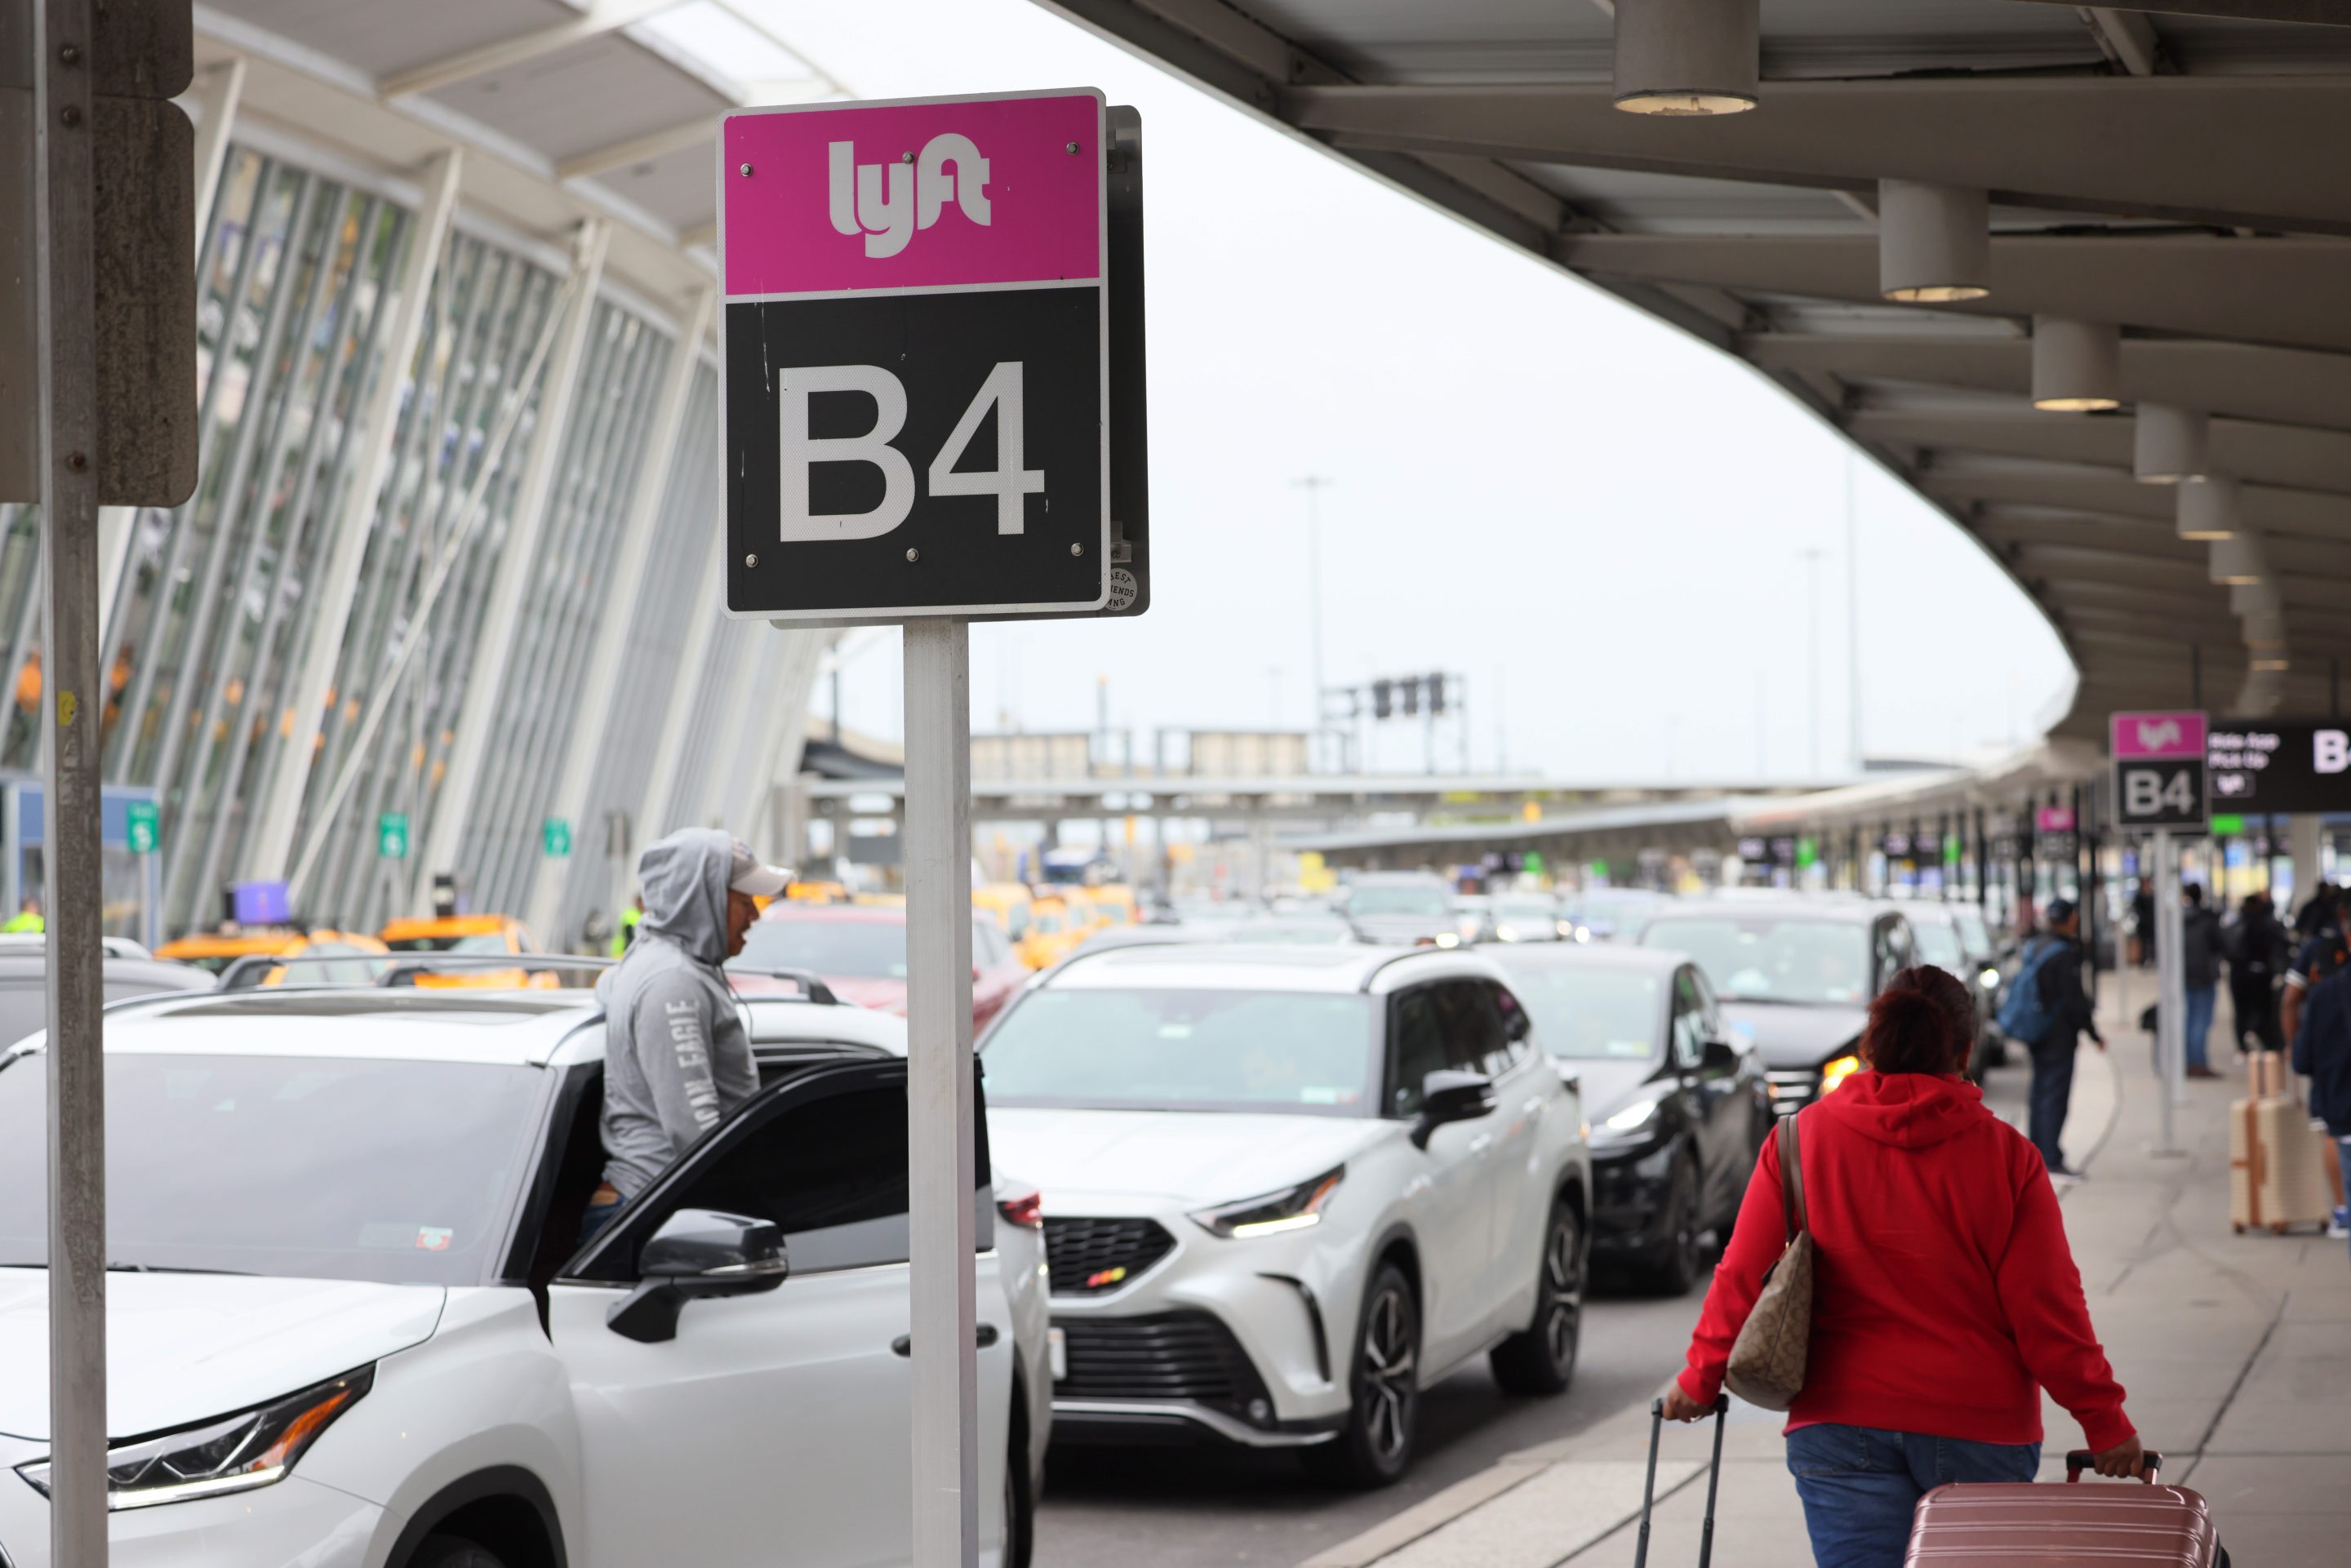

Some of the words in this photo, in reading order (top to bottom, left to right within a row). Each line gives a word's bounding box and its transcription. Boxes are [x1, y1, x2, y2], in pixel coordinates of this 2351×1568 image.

[829, 132, 991, 259] lyft
[780, 361, 1045, 542] B4
[1107, 598, 1126, 607] ANG
[1110, 584, 1135, 597] IENDS
[2313, 729, 2351, 774] B
[2124, 768, 2196, 815] B4
[665, 1000, 709, 1069] EAGLE
